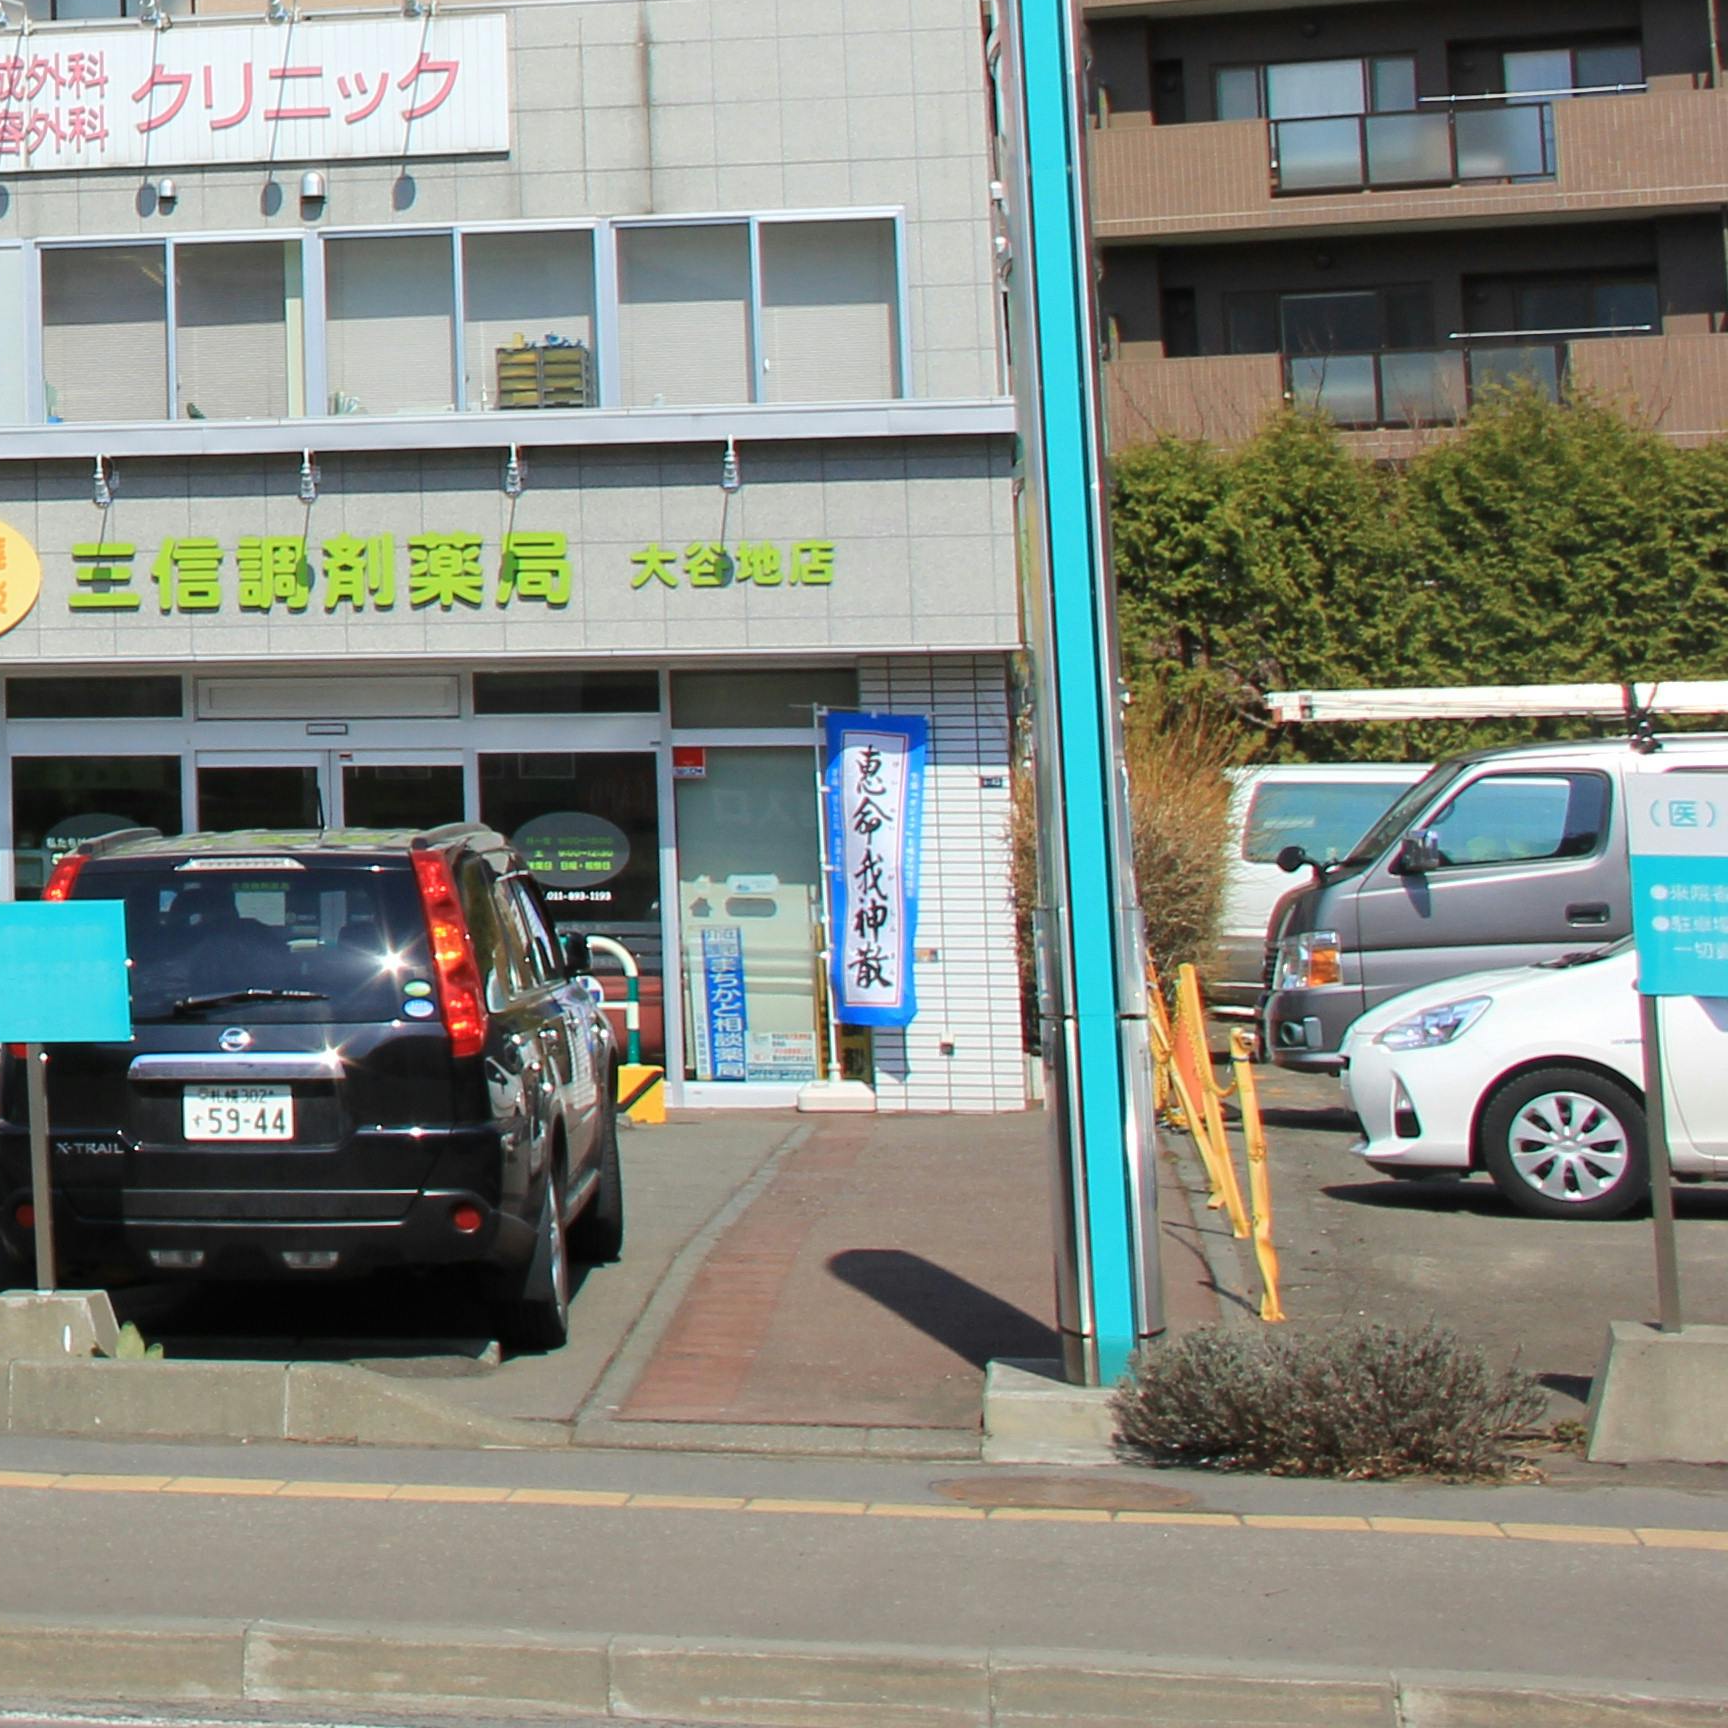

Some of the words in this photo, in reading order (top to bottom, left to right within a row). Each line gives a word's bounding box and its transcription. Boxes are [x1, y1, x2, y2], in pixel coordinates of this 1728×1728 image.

[132, 52, 461, 134] クリニック
[67, 530, 573, 613] 三信調剤薬局
[630, 537, 837, 592] 大谷地店
[55, 1141, 125, 1155] X-TRAIL
[207, 1106, 286, 1135] 59-44
